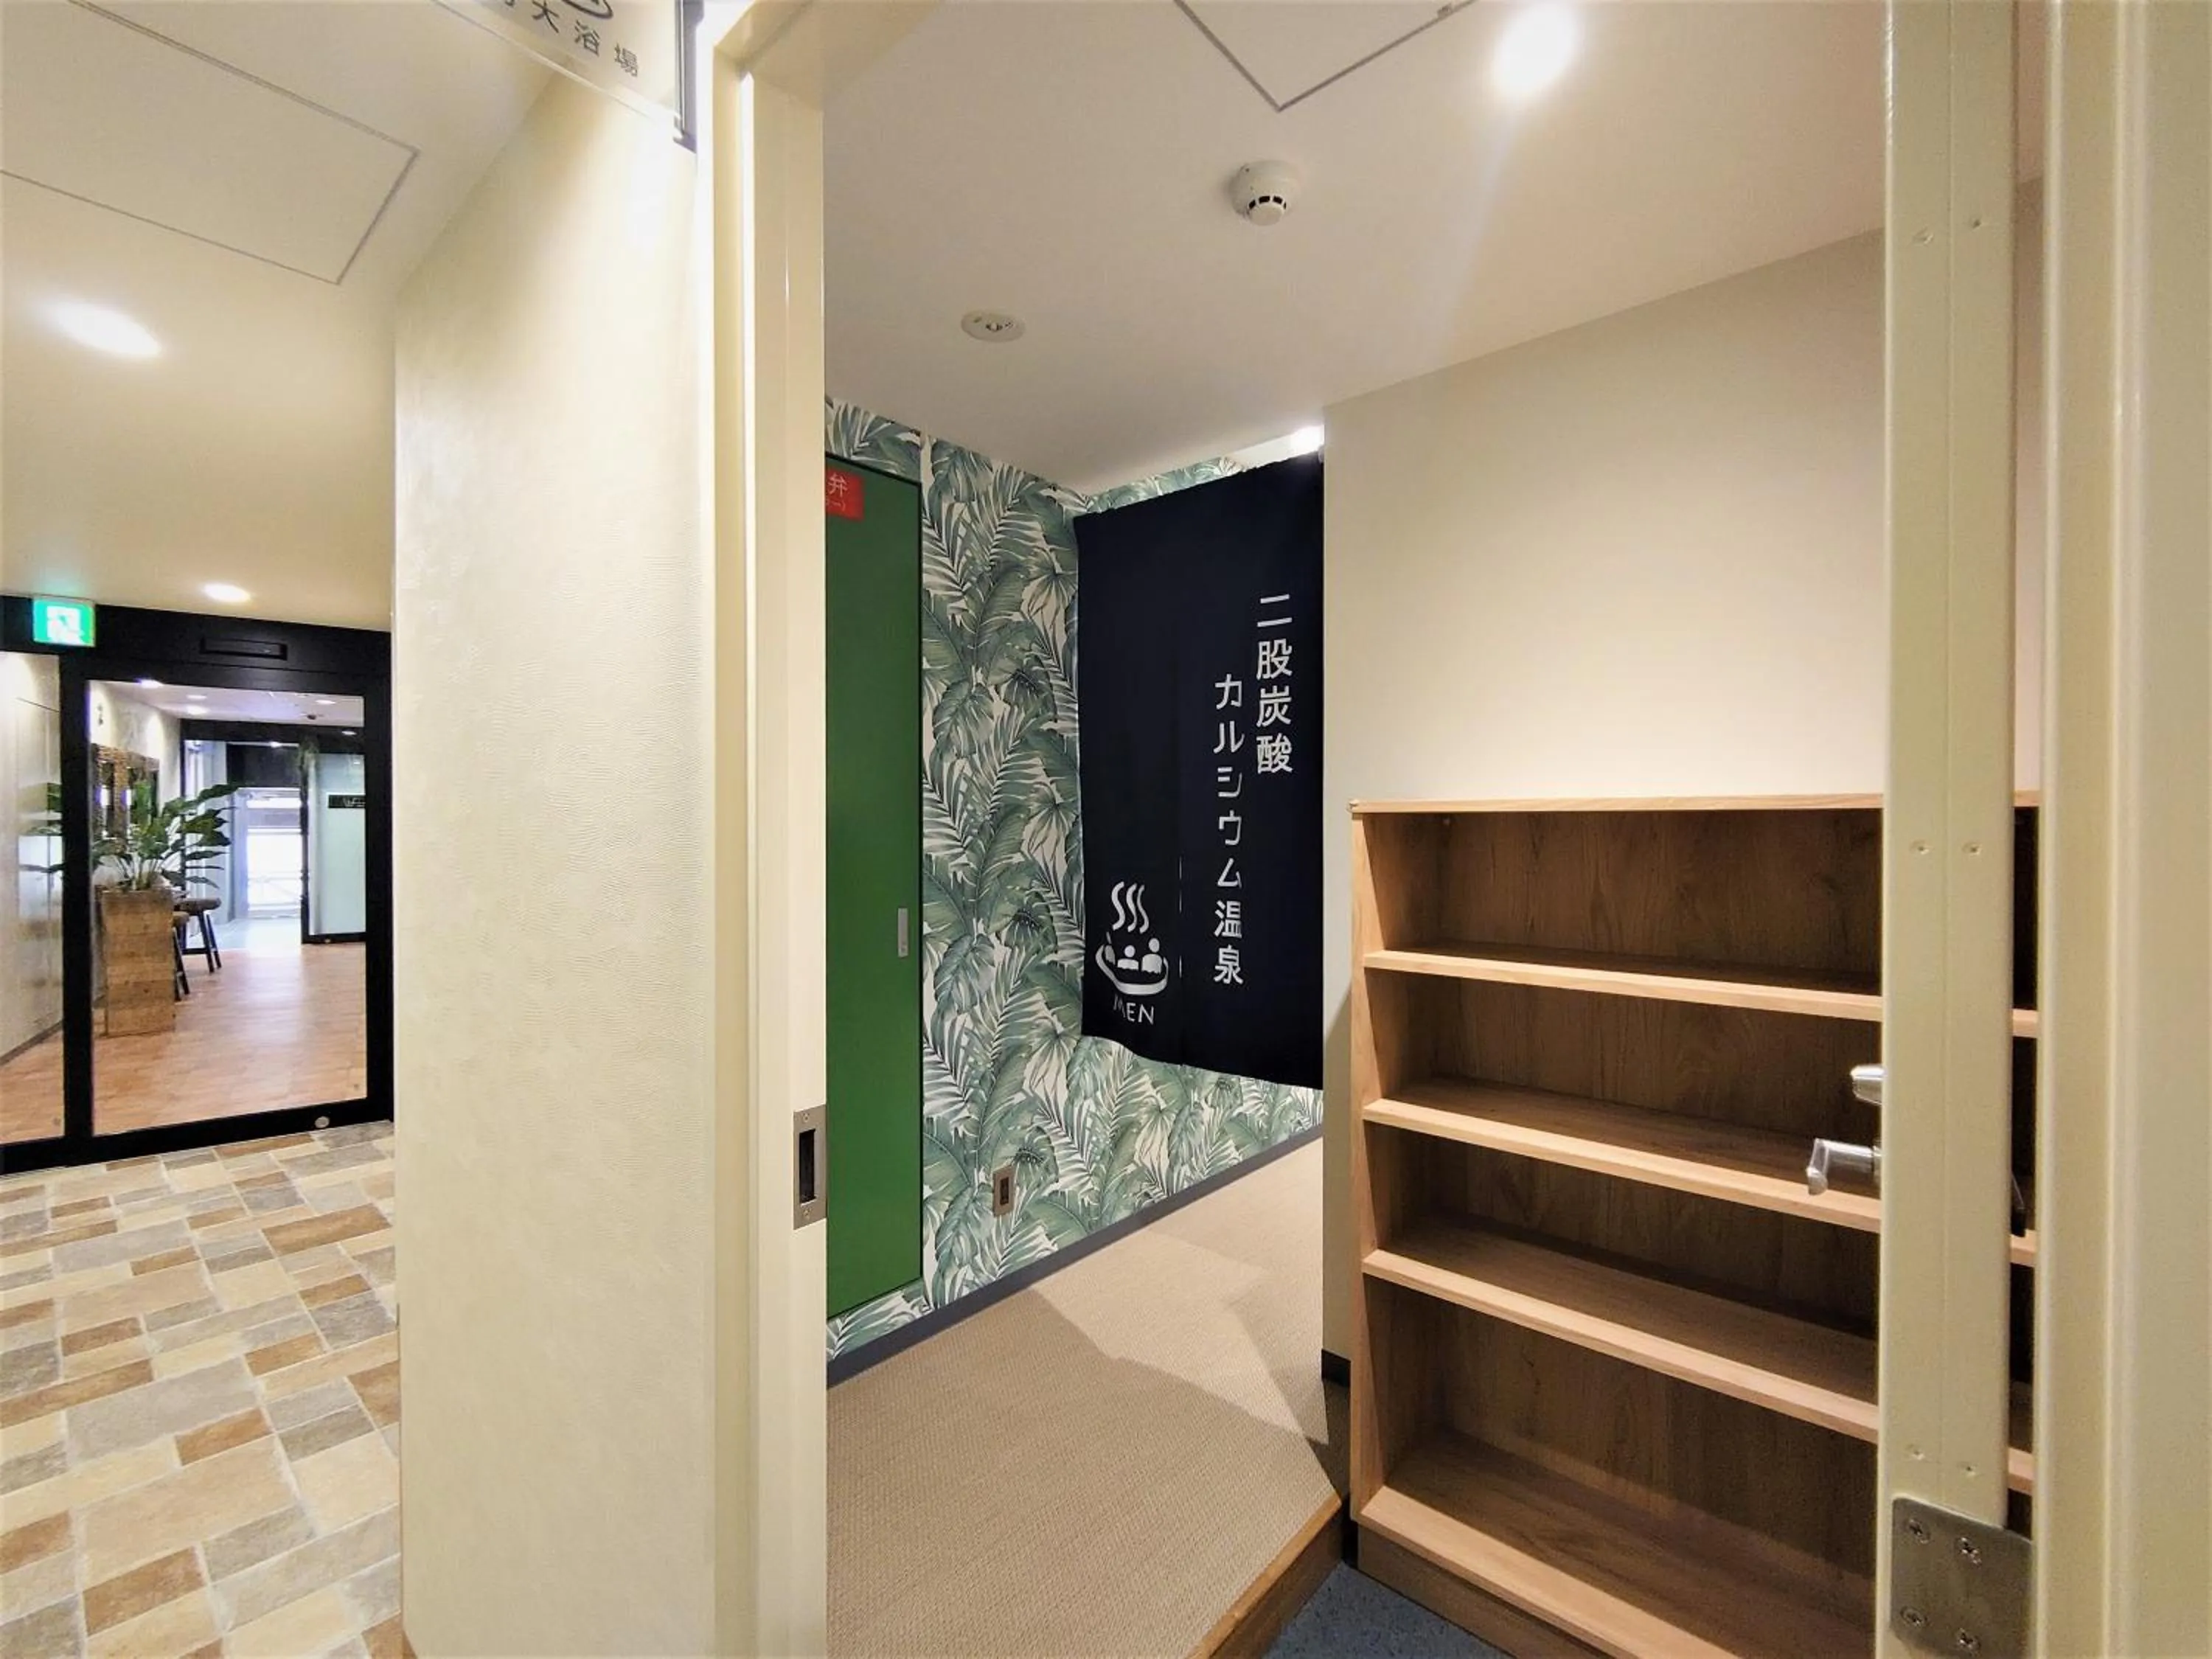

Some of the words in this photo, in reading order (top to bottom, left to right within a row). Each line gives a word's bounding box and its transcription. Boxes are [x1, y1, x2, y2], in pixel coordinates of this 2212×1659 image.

[503, 0, 639, 77] 大浴場
[1256, 594, 1293, 774] 二股炭酸
[1213, 673, 1245, 985] カルシウム温泉
[1113, 993, 1155, 1025] MEN
